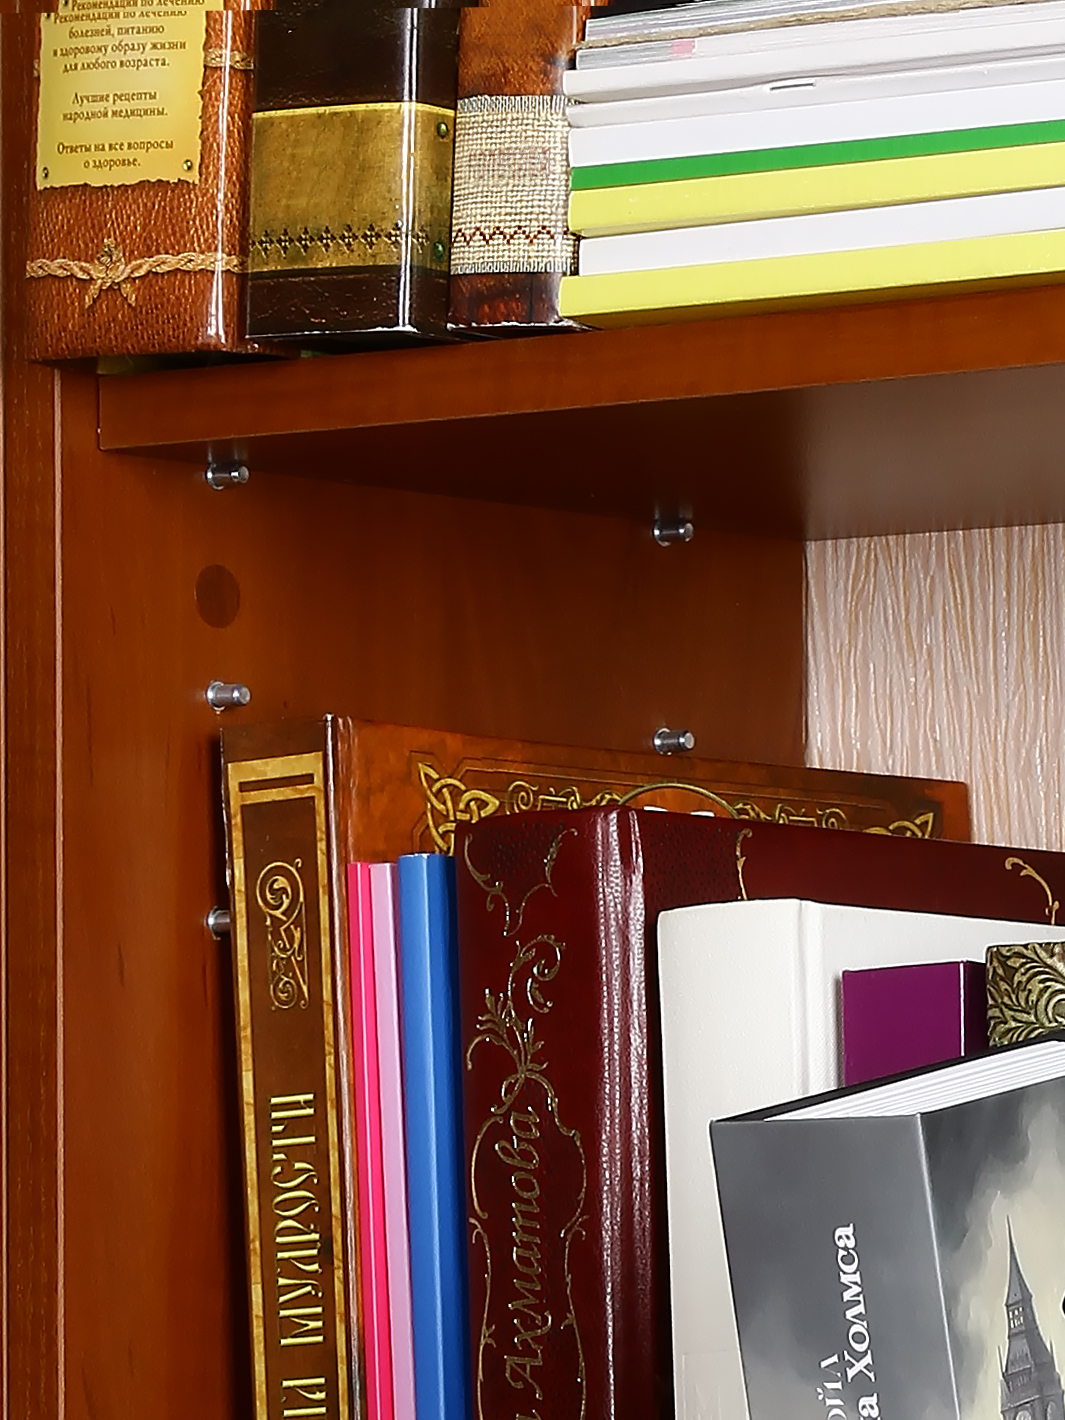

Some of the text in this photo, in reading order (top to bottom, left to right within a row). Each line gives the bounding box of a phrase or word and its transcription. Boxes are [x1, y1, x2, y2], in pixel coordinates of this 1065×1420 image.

[68, 24, 165, 39] болезней, питанию
[60, 43, 109, 59] здоровому
[111, 40, 147, 55] образу
[150, 41, 186, 51] жизни
[62, 57, 170, 73] для любого возраста.
[72, 91, 157, 107] Лучшие рецепты
[62, 107, 168, 123] народной медицины.
[57, 142, 92, 155] Ответы
[108, 143, 125, 151] все
[127, 140, 174, 153] вопросы
[83, 158, 141, 171] о здоровье.
[495, 1106, 552, 1399] Ахматова
[833, 1223, 877, 1384] Холмса
